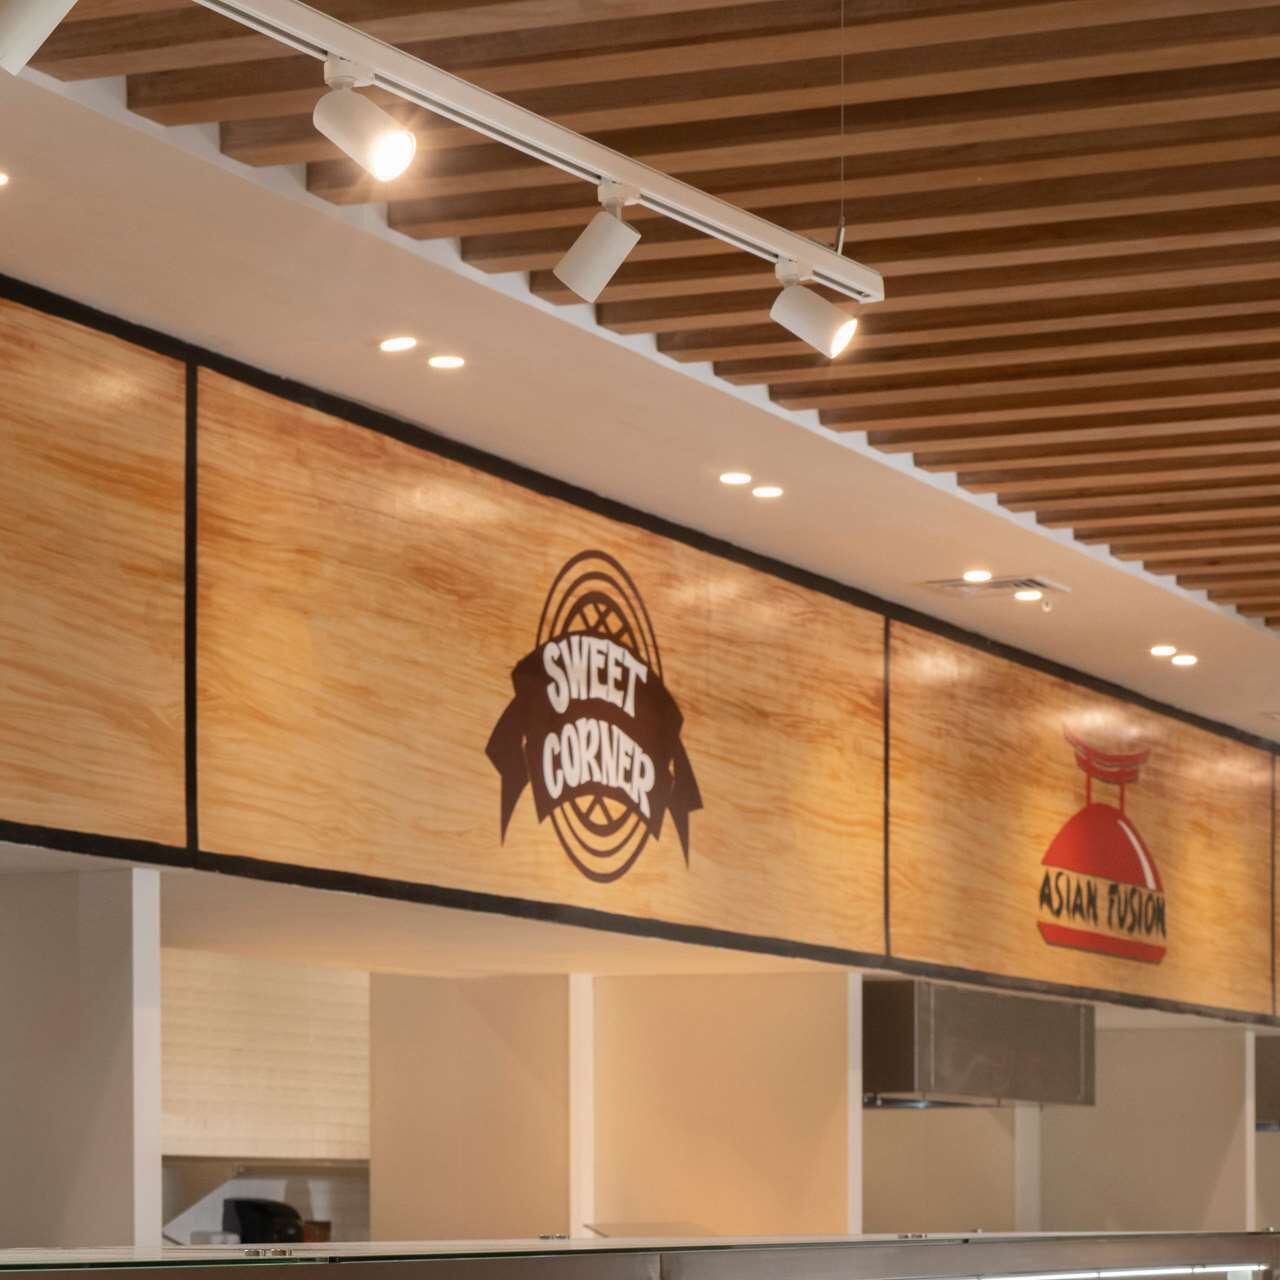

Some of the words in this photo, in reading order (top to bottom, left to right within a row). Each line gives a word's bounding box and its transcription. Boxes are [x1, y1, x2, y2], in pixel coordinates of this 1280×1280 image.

[542, 633, 649, 718] SWEET
[542, 717, 656, 819] CORNER
[1038, 869, 1098, 927] ASIAN
[1107, 883, 1167, 939] FUSION
